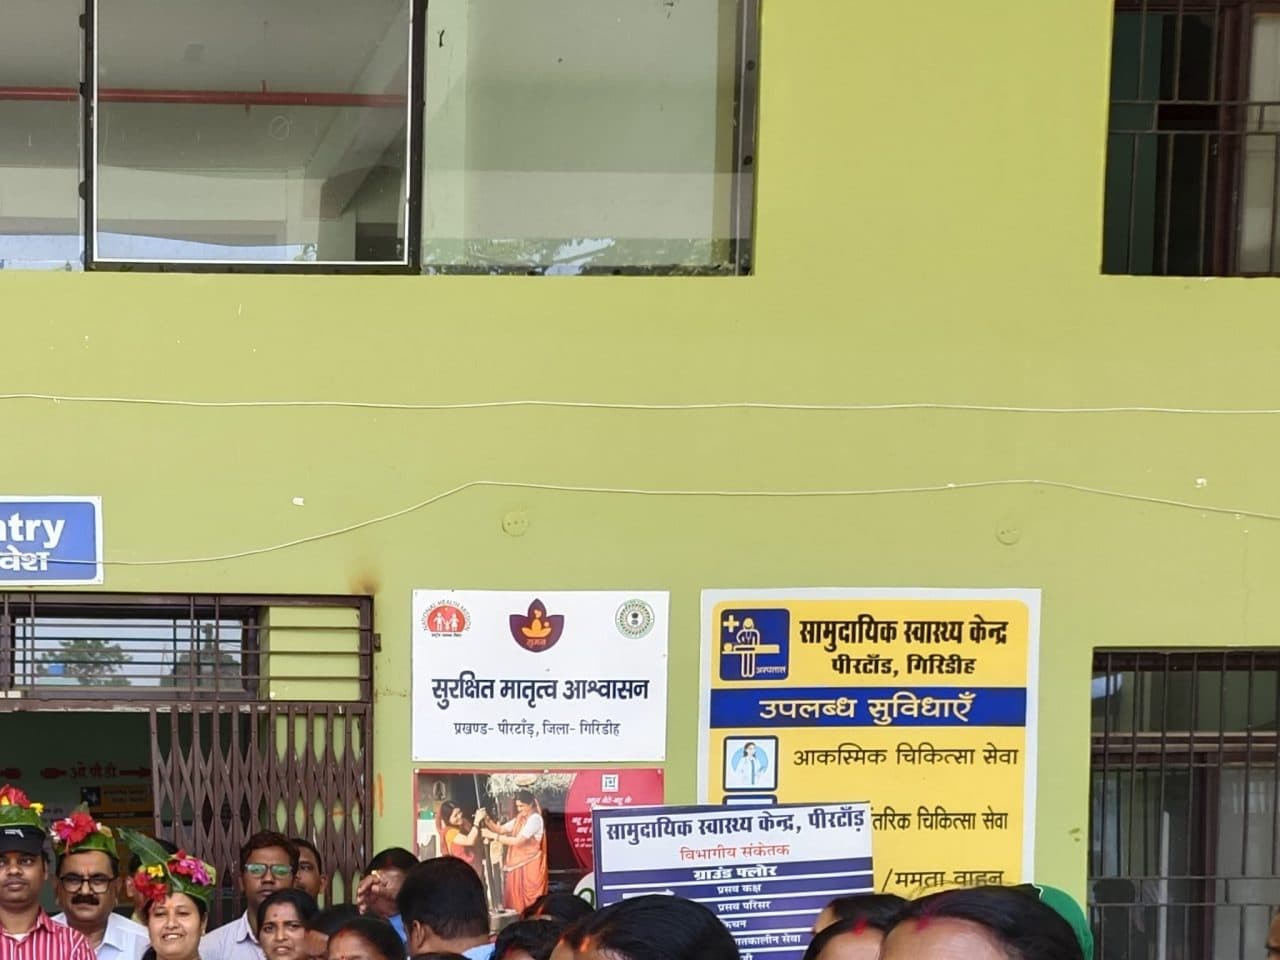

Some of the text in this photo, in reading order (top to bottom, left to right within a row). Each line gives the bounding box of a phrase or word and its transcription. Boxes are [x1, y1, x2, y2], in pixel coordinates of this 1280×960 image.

[799, 614, 1009, 652] सामुदायिक स्वास्थ्य केन्द्र
[907, 653, 977, 675] गिरिडीह
[432, 670, 650, 709] सुरक्षित मातृत्व आश्वासन
[759, 691, 977, 725] उपलब्ध सुविधाएँ
[542, 720, 576, 735] जिला-
[580, 720, 621, 736] गिरिडीह
[793, 741, 1019, 766] आकस्मिक चिकित्सा सेवा
[606, 817, 693, 845] सामुदायिक
[698, 815, 753, 836] स्वास्थ्य
[758, 811, 802, 834] केन्द्र,
[917, 805, 977, 831] चिकित्सा
[981, 805, 1009, 831] सेवा
[680, 842, 791, 862] विभागीय संकेतक
[693, 866, 733, 881] ग्राउंड
[782, 933, 801, 944] सेवा
